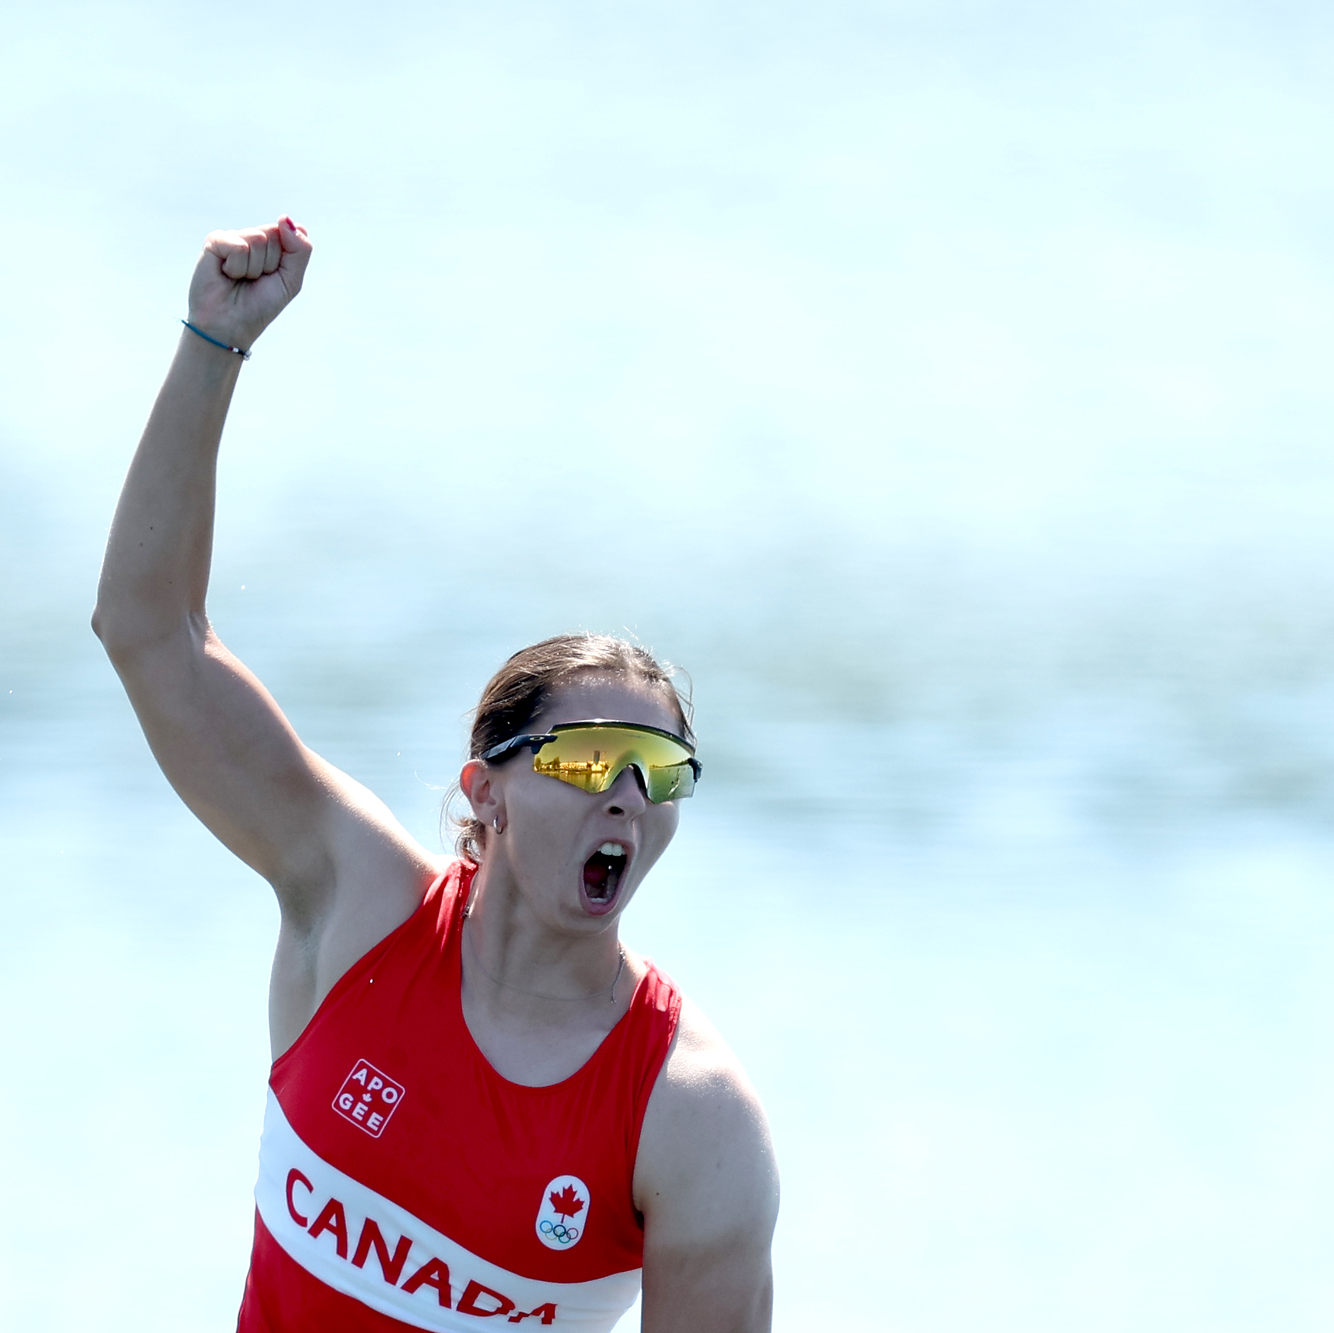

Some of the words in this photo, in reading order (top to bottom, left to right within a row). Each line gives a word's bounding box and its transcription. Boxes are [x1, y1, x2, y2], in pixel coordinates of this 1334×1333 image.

[352, 1068, 398, 1104] APO
[339, 1093, 384, 1131] GEE
[286, 1168, 557, 1325] CANADA
